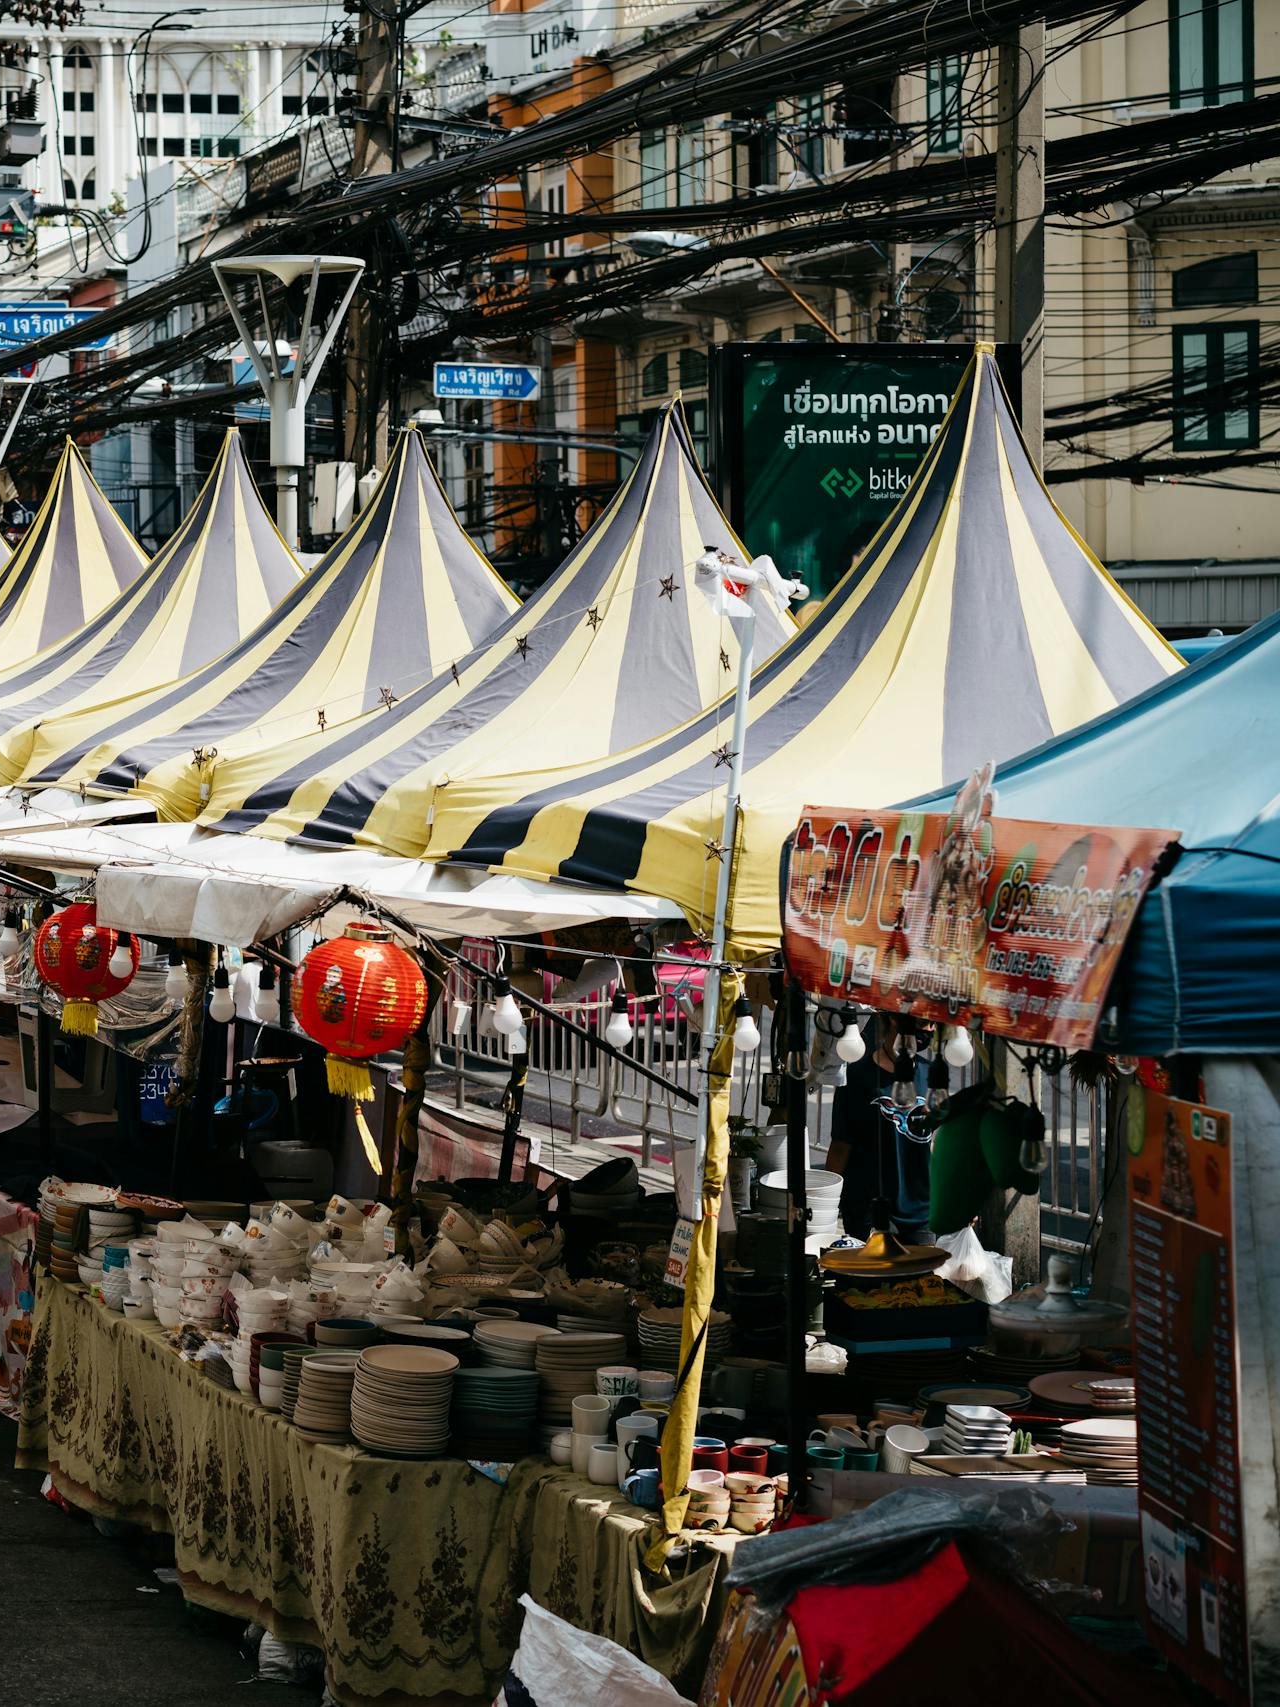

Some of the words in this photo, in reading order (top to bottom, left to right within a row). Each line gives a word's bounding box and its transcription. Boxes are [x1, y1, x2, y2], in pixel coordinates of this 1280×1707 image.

[531, 29, 548, 59] LH
[13, 313, 85, 337] เจริญเวี
[454, 367, 523, 388] เจริญเวียง
[439, 386, 474, 396] Charoen
[478, 387, 504, 397] Wiang
[783, 379, 957, 422] เชื่อมทุกโอกา
[783, 424, 871, 450] สู่โลกแห่ง
[869, 466, 912, 490] bitk
[869, 491, 889, 500] Capital
[667, 1261, 681, 1276] SALE
